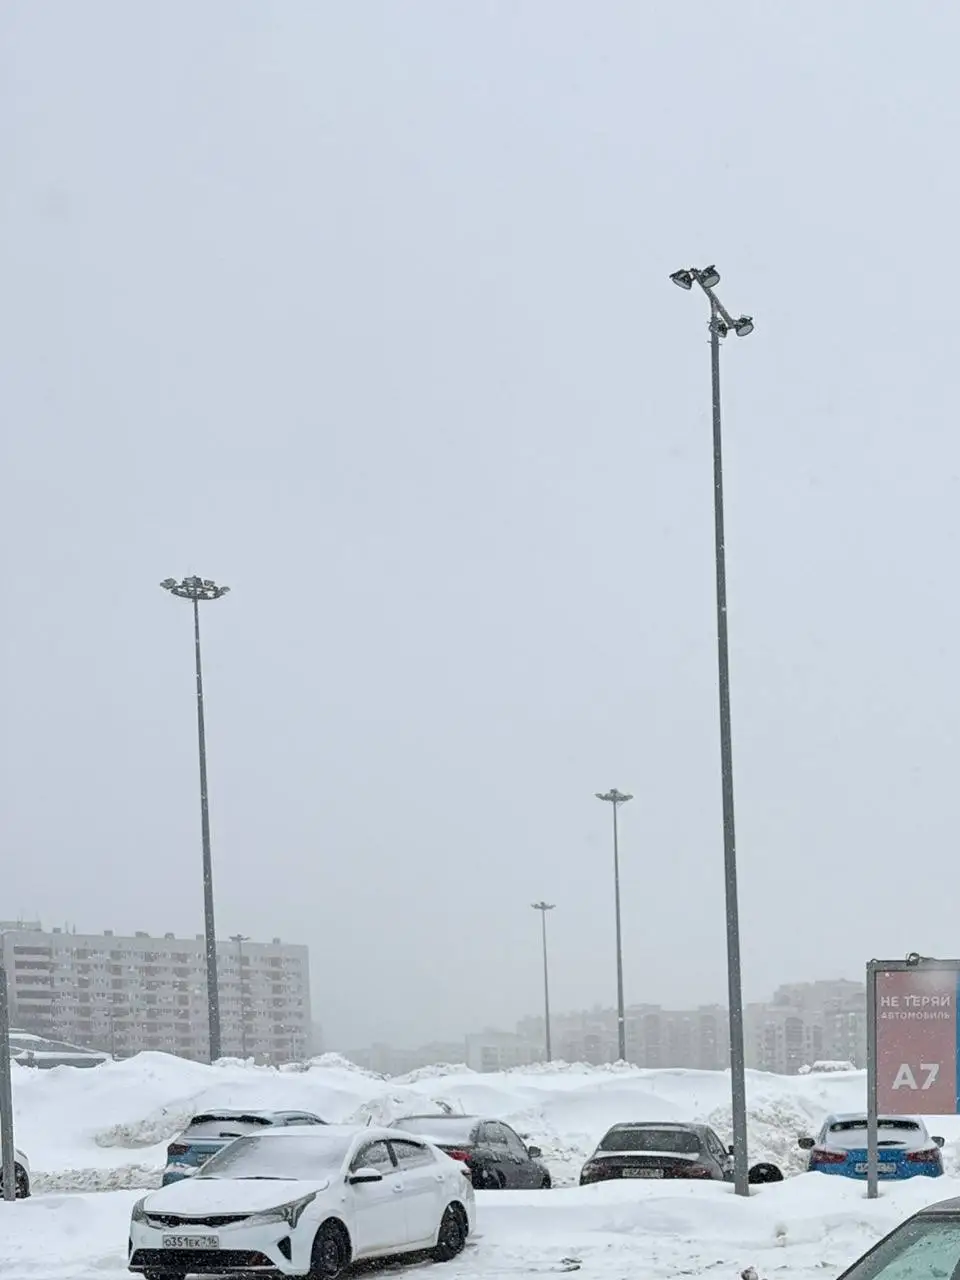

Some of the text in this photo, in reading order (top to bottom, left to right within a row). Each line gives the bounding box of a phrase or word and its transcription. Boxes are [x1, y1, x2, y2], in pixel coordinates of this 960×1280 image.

[881, 996, 899, 1007] НЕ
[881, 1011, 950, 1020] АВТОМОБИЛЬ
[891, 1063, 939, 1090] А7
